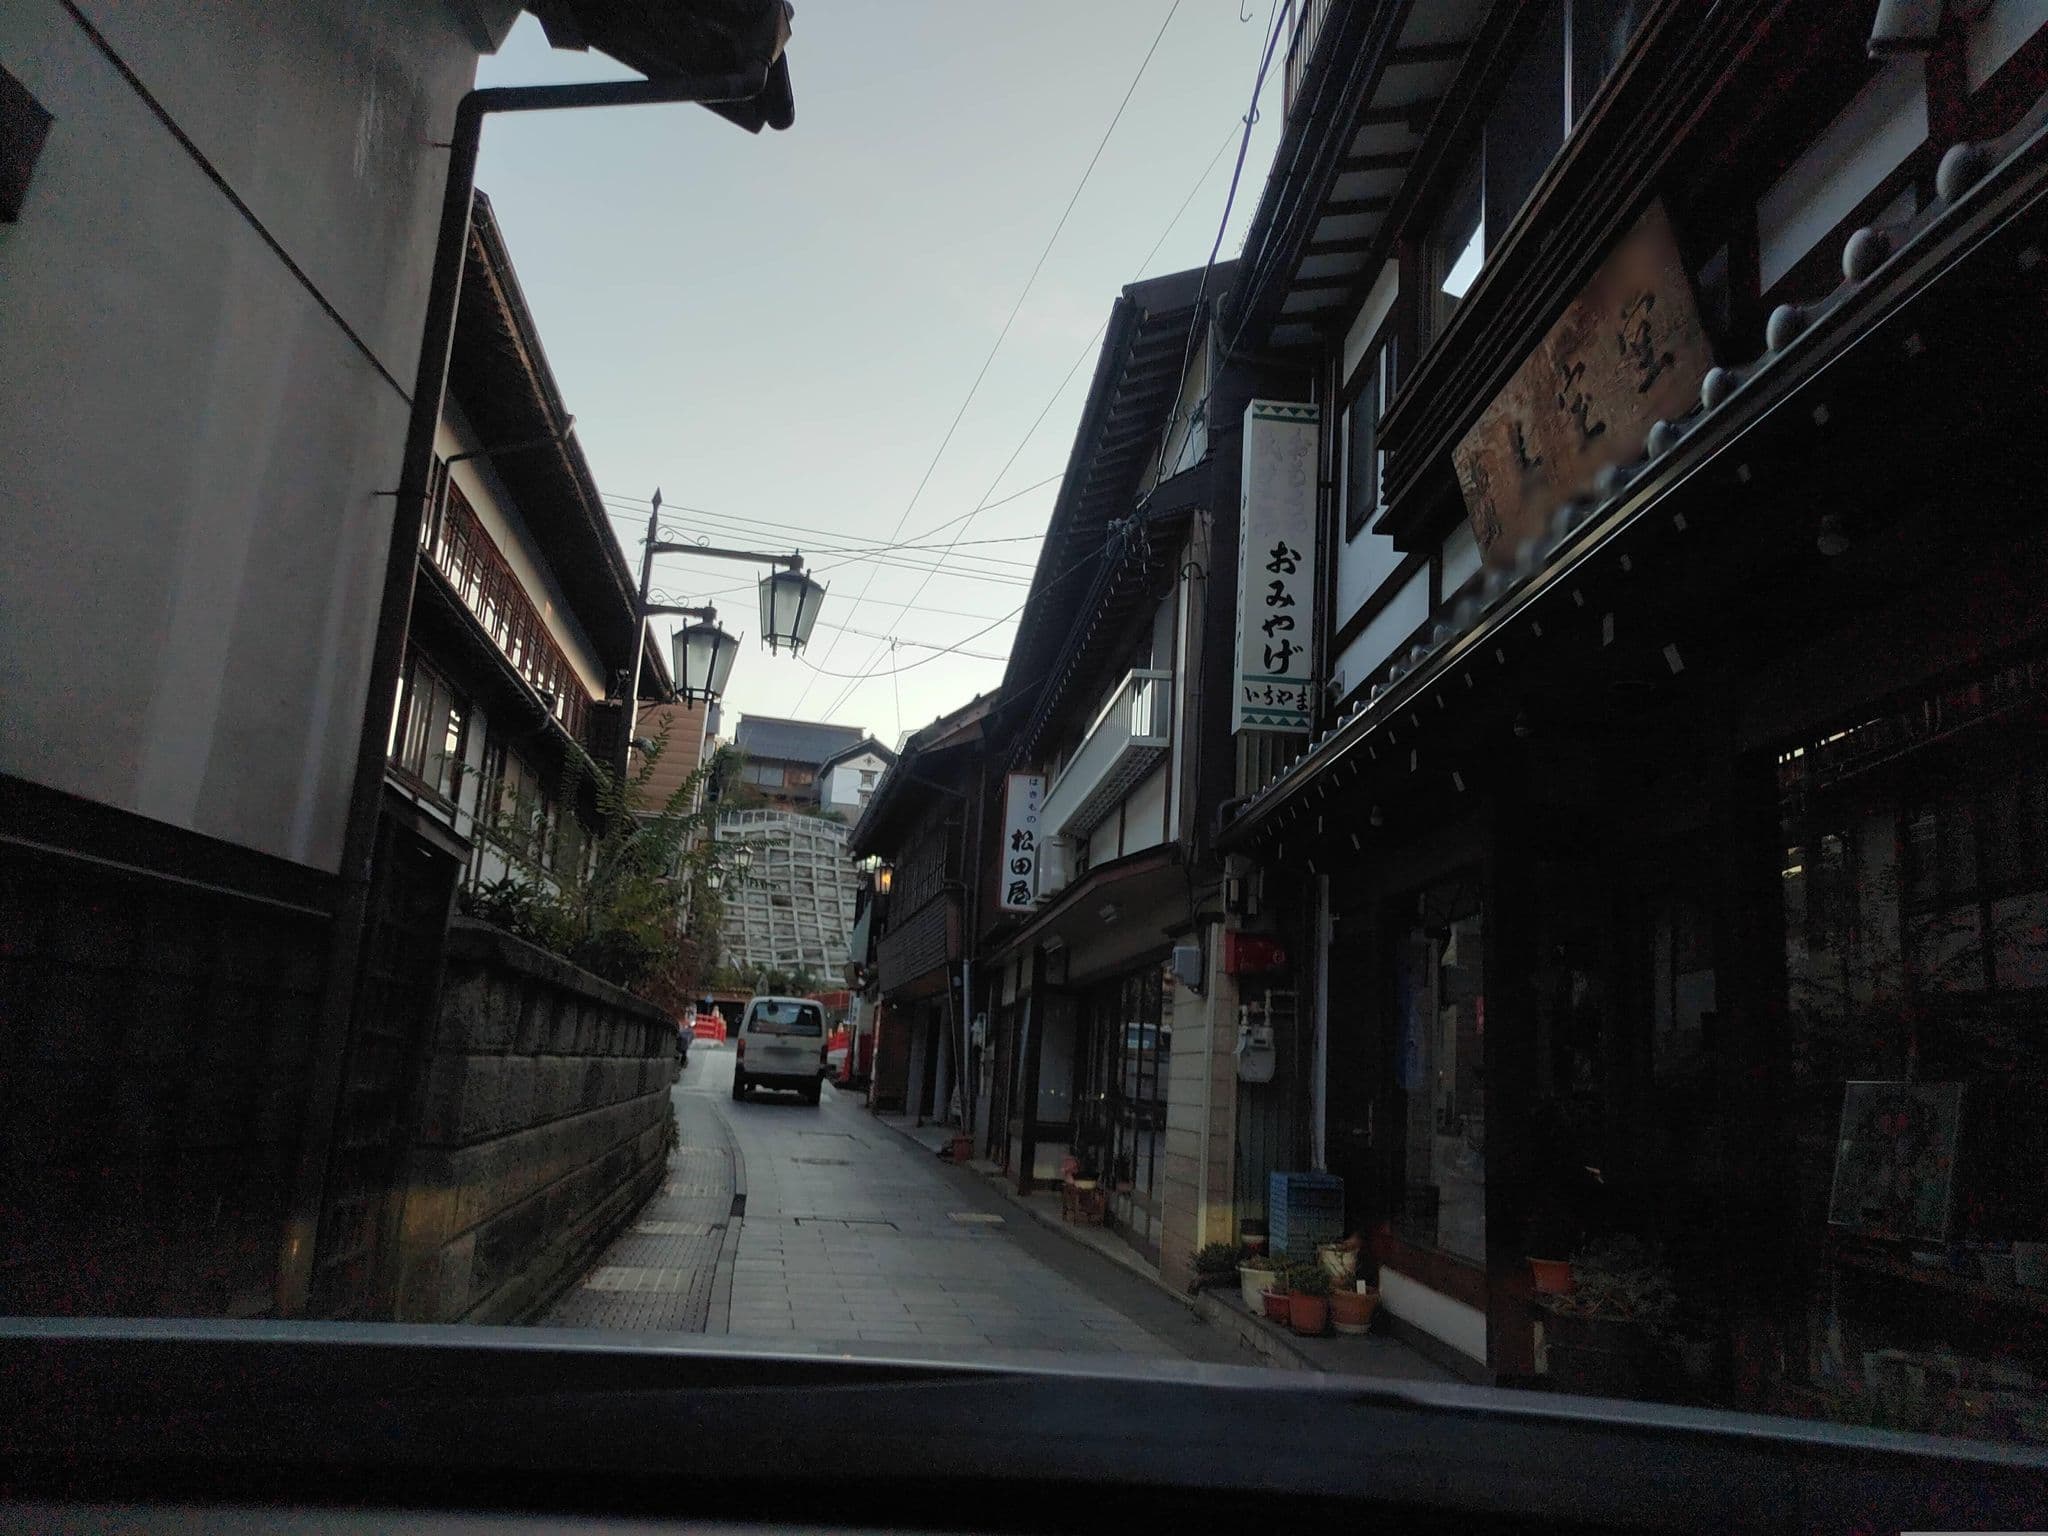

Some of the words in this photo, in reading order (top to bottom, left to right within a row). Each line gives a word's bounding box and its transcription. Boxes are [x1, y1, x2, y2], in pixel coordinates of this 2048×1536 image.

[1262, 541, 1303, 675] おみやげ
[1244, 685, 1308, 711] いちやま
[1027, 778, 1039, 824] はきもの
[1007, 829, 1034, 905] 松田屋
